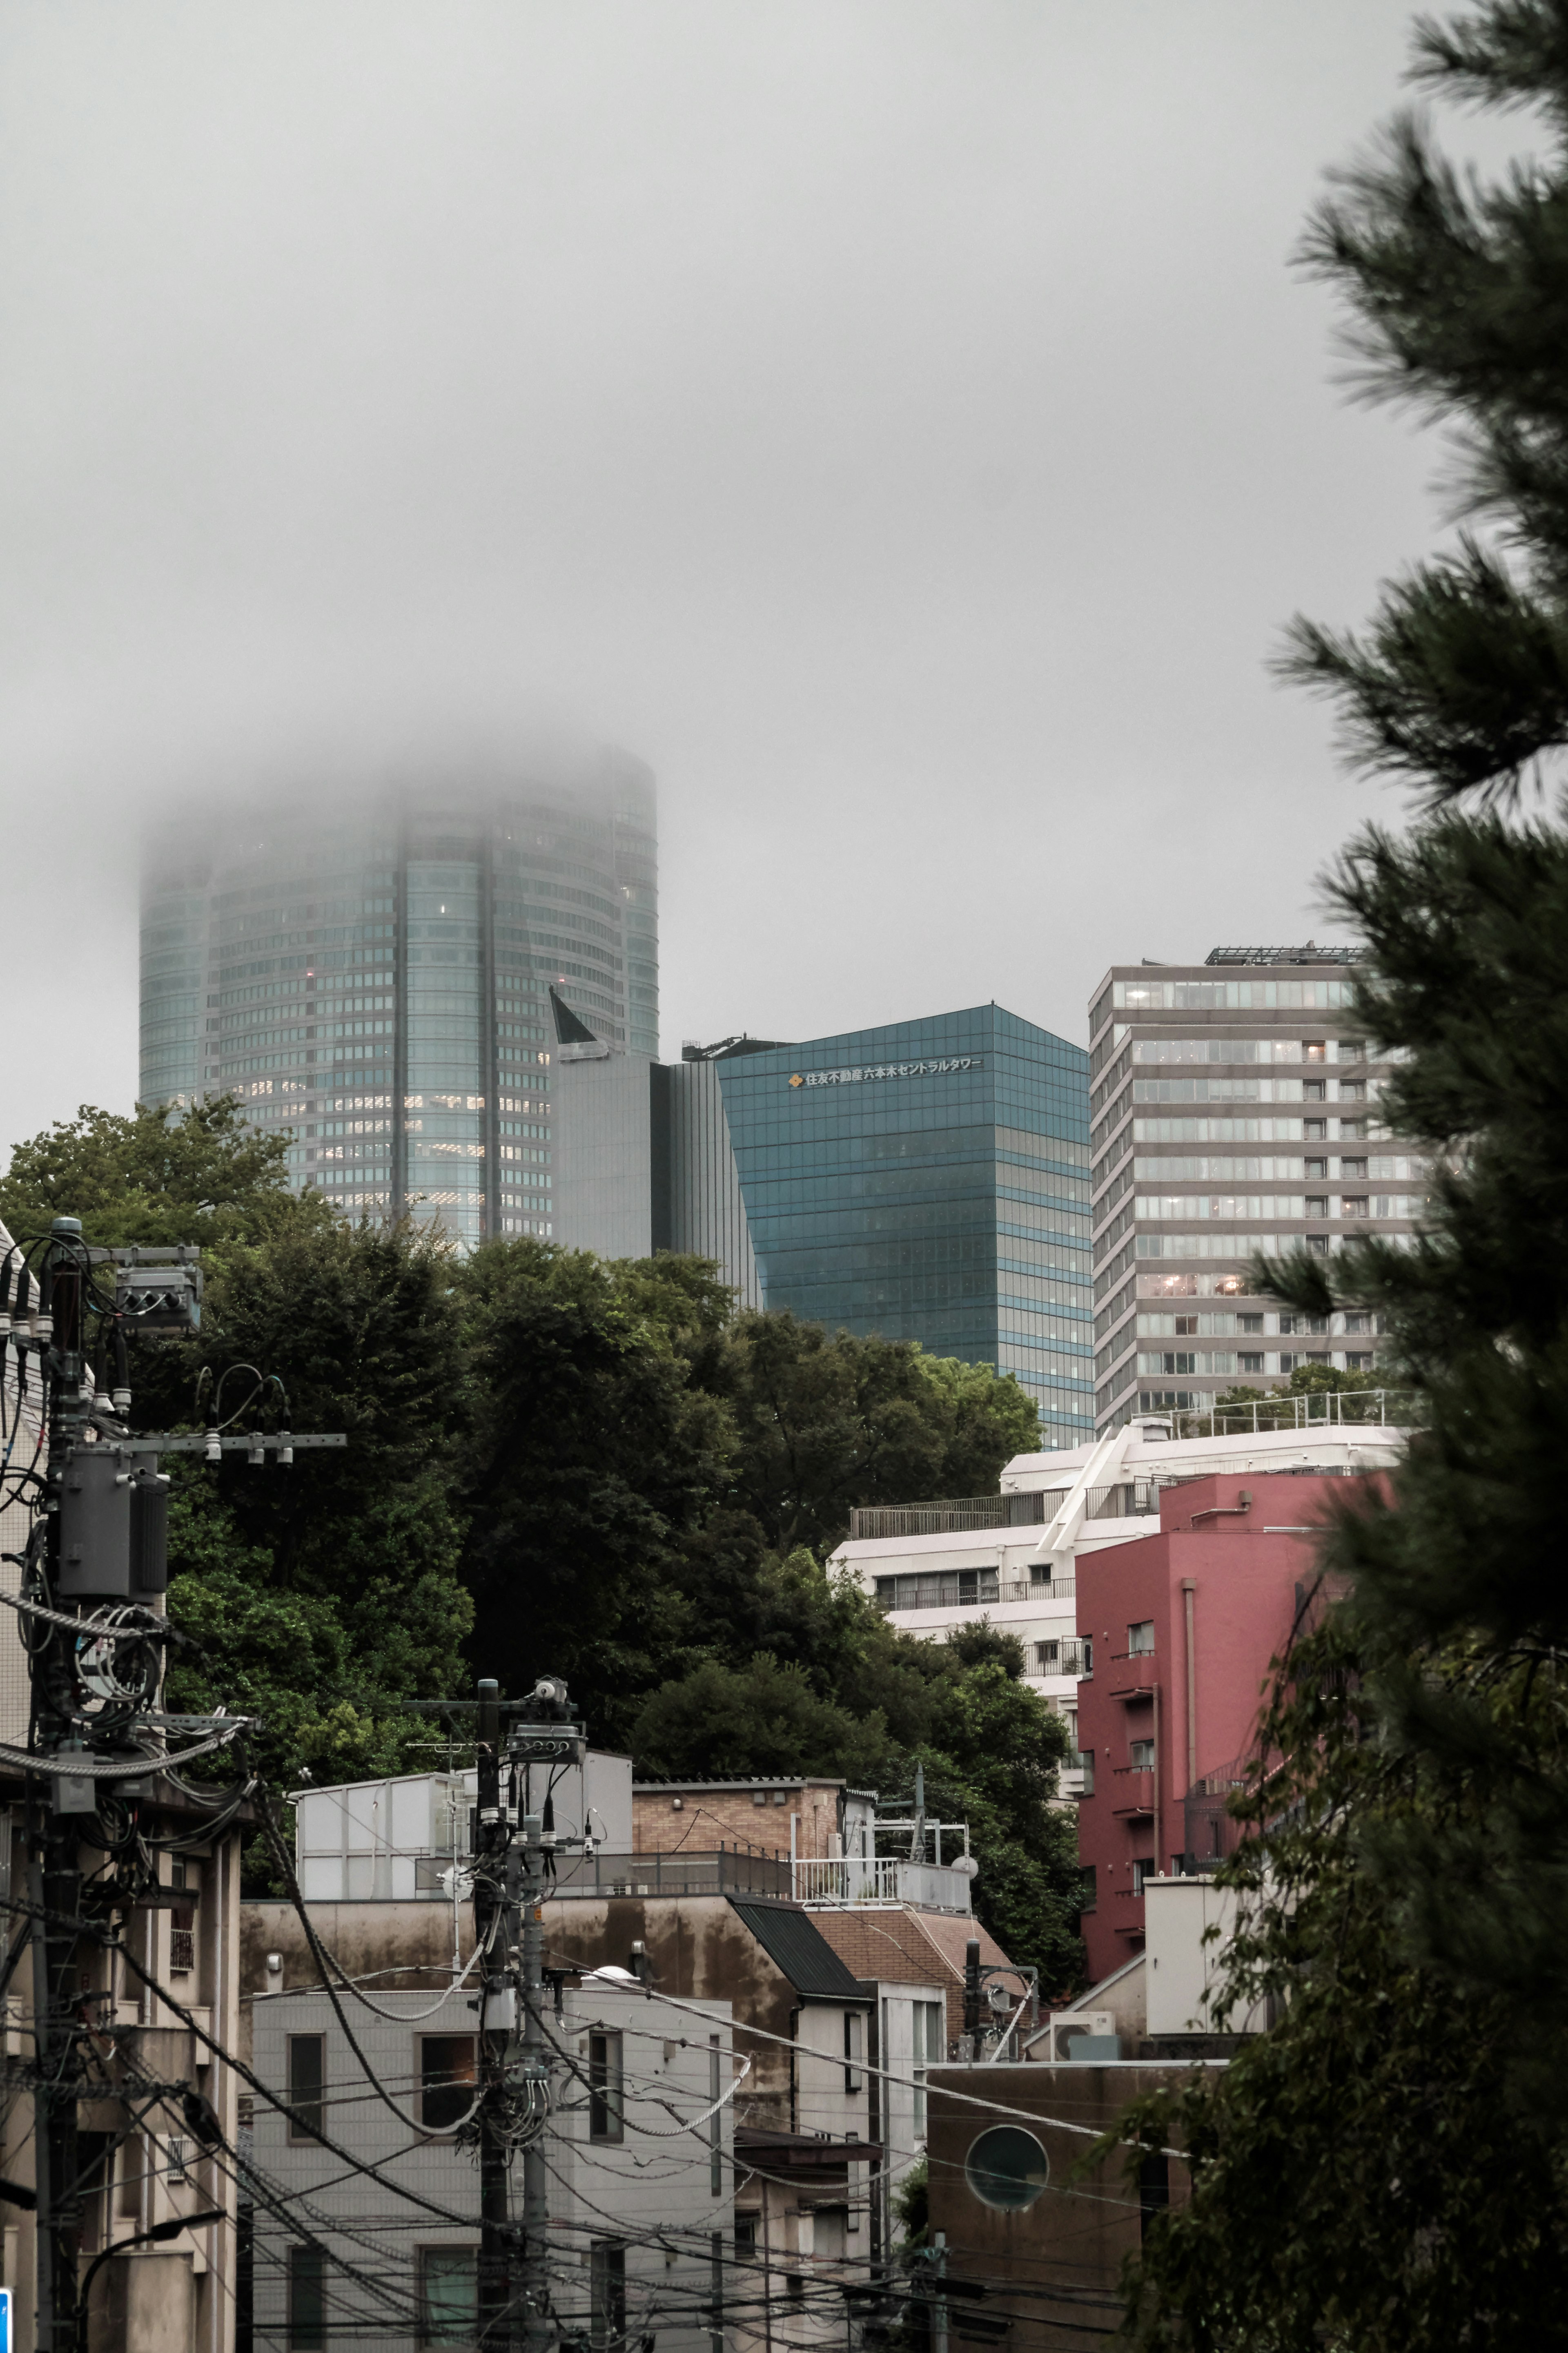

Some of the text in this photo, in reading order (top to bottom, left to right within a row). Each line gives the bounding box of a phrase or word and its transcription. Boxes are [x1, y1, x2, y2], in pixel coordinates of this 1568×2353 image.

[806, 1058, 981, 1086] 住友不動産六本木セントラルタワー
